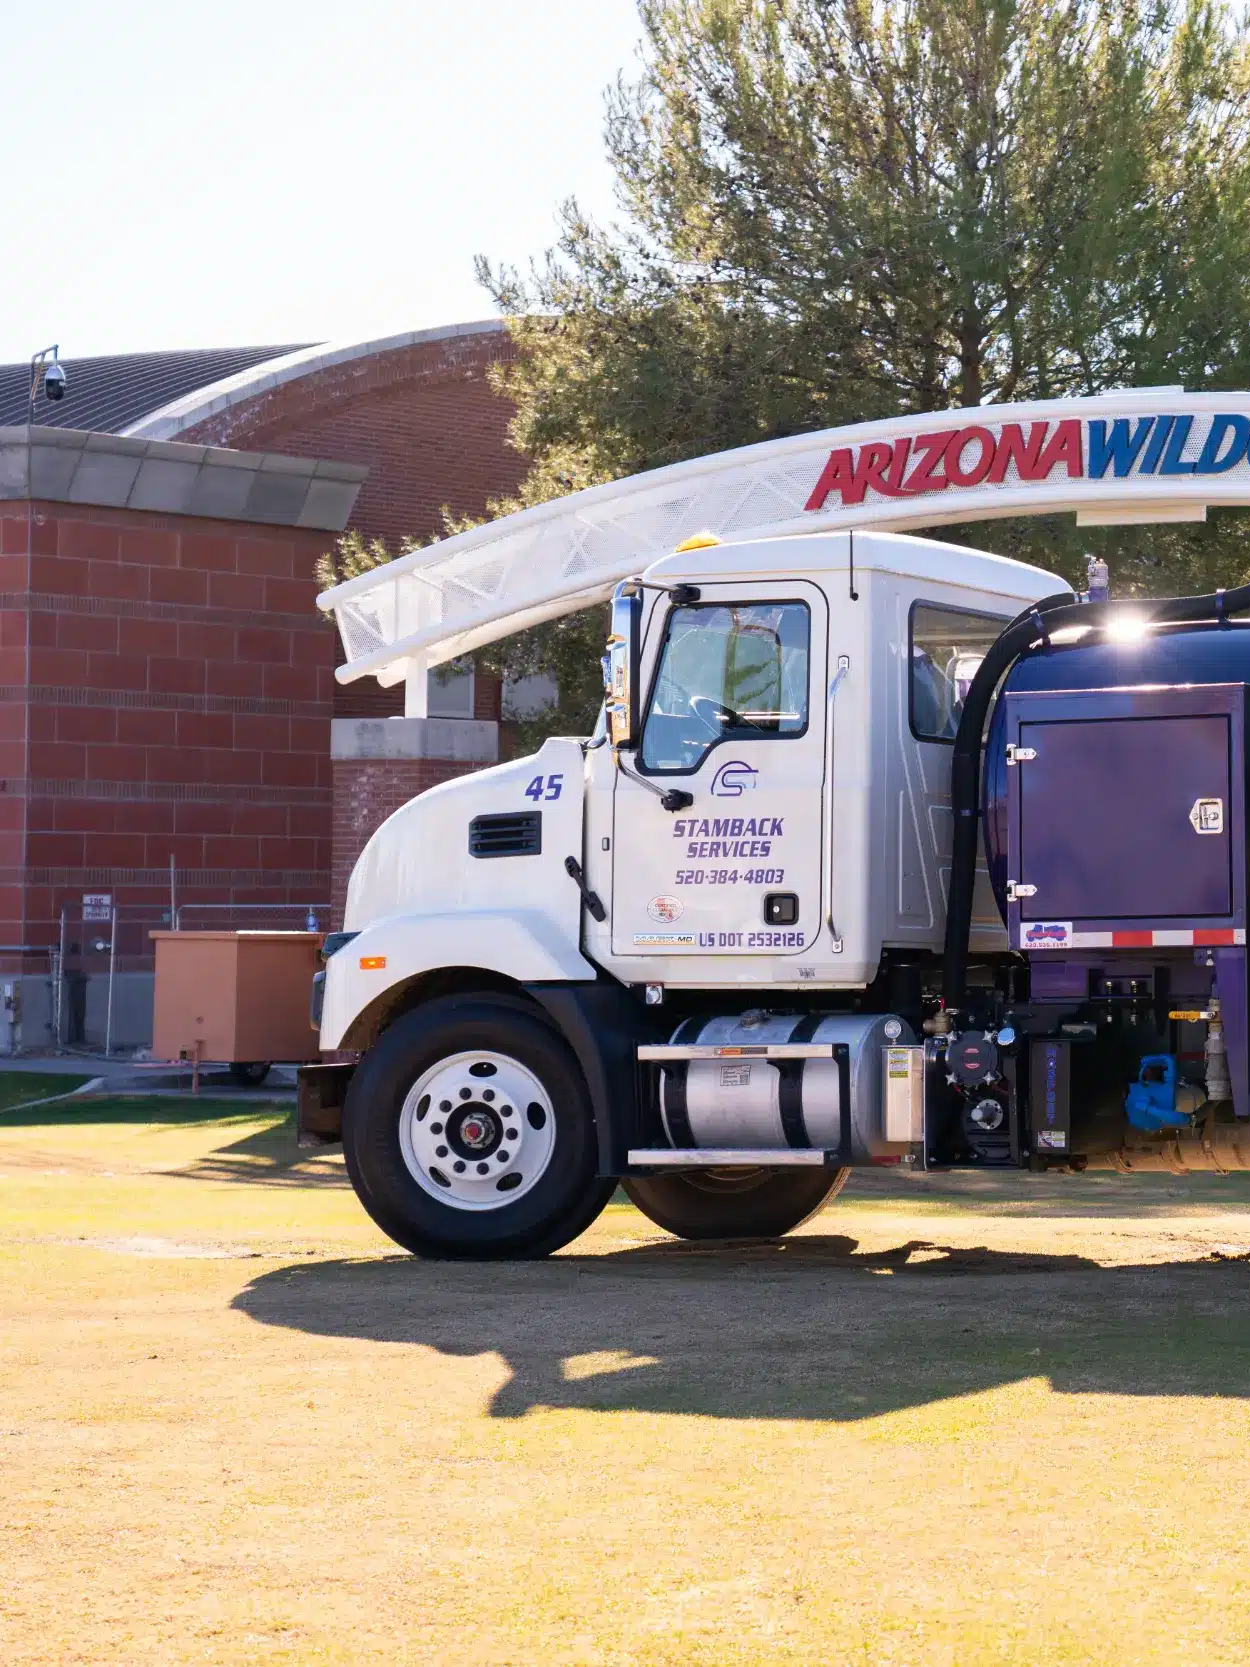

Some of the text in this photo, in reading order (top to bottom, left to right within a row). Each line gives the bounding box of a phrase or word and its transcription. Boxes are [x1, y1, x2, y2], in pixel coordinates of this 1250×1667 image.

[804, 418, 1083, 511] ARIZONA
[524, 773, 564, 802] 45
[672, 818, 785, 838] STAMBACK
[686, 841, 771, 858] SERVICES
[699, 932, 805, 947] US DOT 2532126
